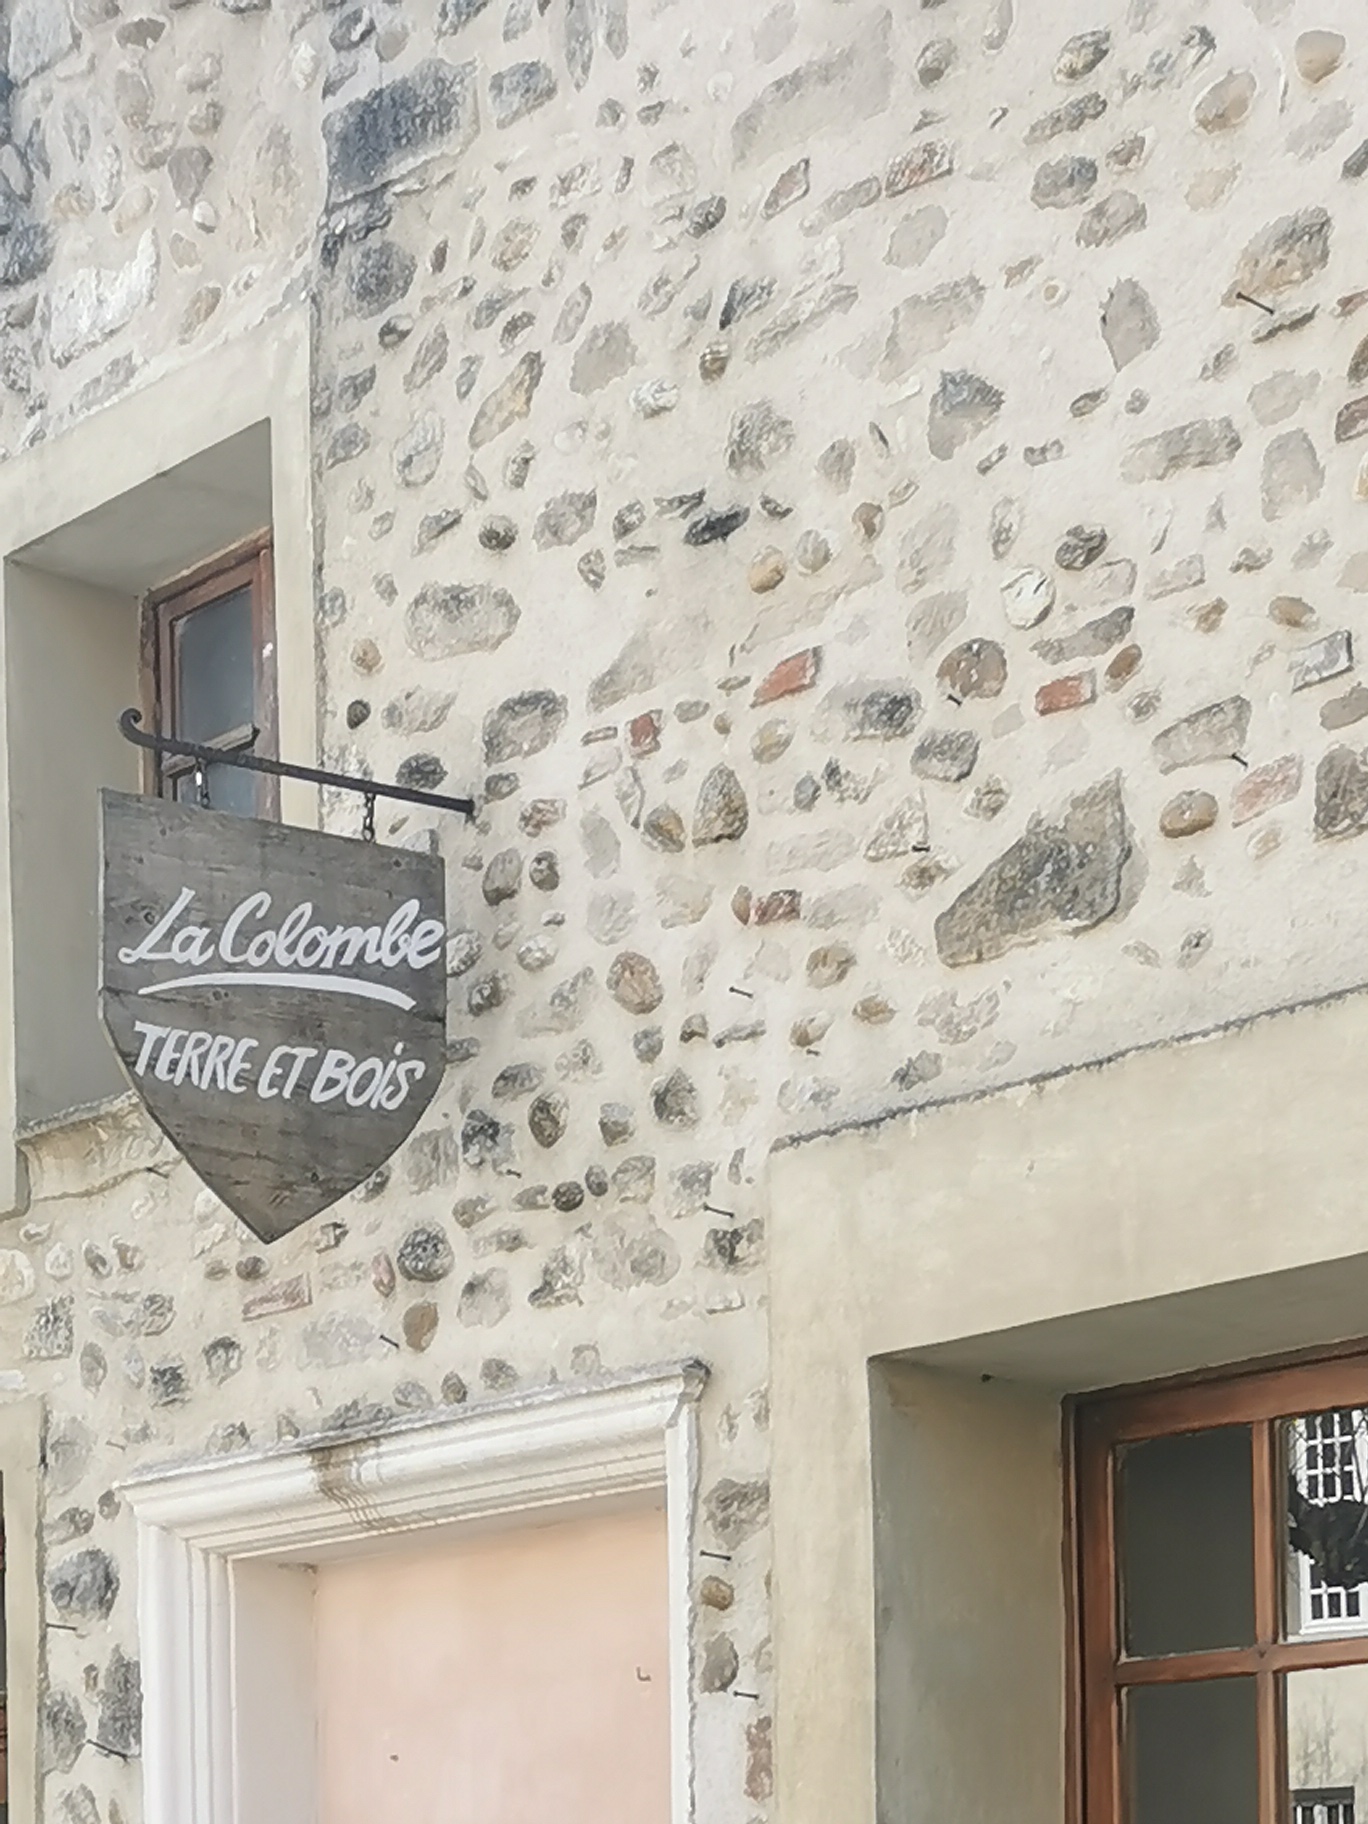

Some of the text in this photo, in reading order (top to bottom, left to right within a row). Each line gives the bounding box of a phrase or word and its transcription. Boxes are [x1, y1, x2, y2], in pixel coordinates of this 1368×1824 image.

[118, 886, 444, 969] La Colombe
[133, 1020, 259, 1094] TERRE
[258, 1045, 315, 1100] ET
